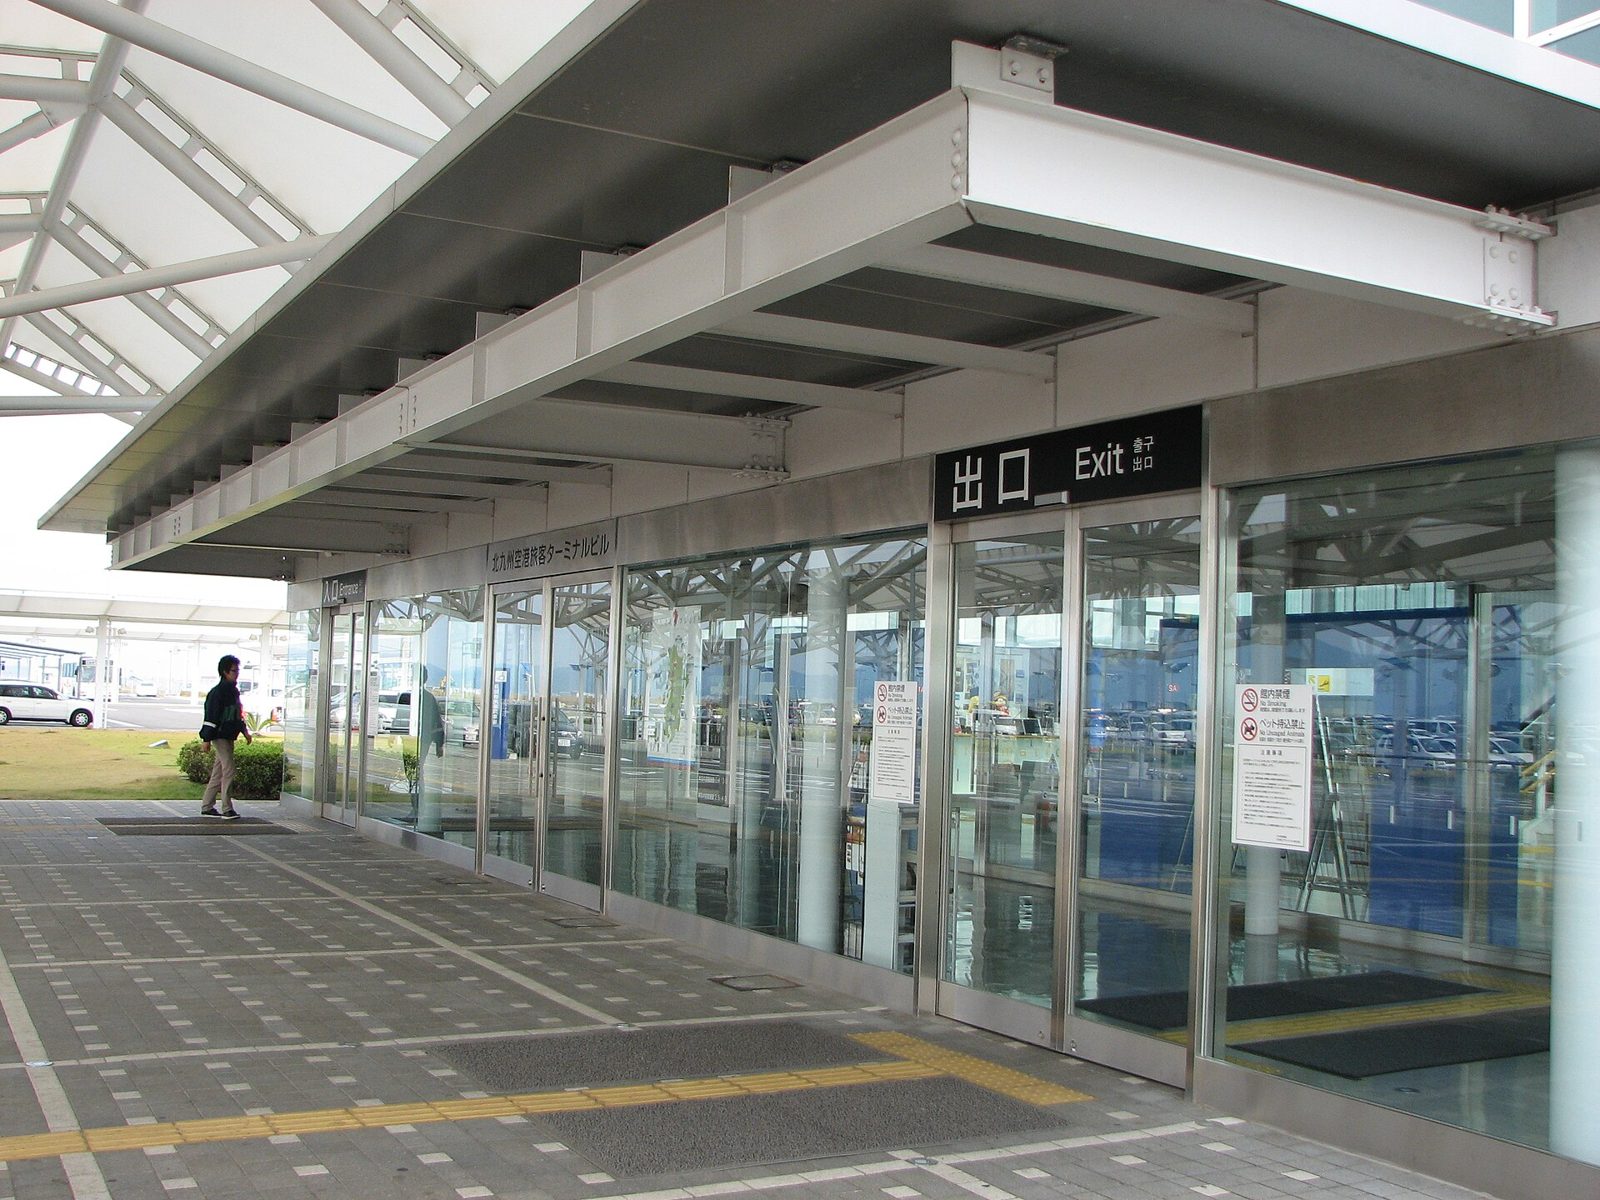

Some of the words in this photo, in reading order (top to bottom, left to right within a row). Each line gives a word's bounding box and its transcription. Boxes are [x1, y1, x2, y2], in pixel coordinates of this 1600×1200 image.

[952, 448, 1030, 512] 出口
[1075, 442, 1124, 481] Exit
[1132, 456, 1153, 472] 出口
[491, 533, 610, 573] 北九州空港旅客ターミナルビル
[1260, 688, 1290, 699] 館内禁煙
